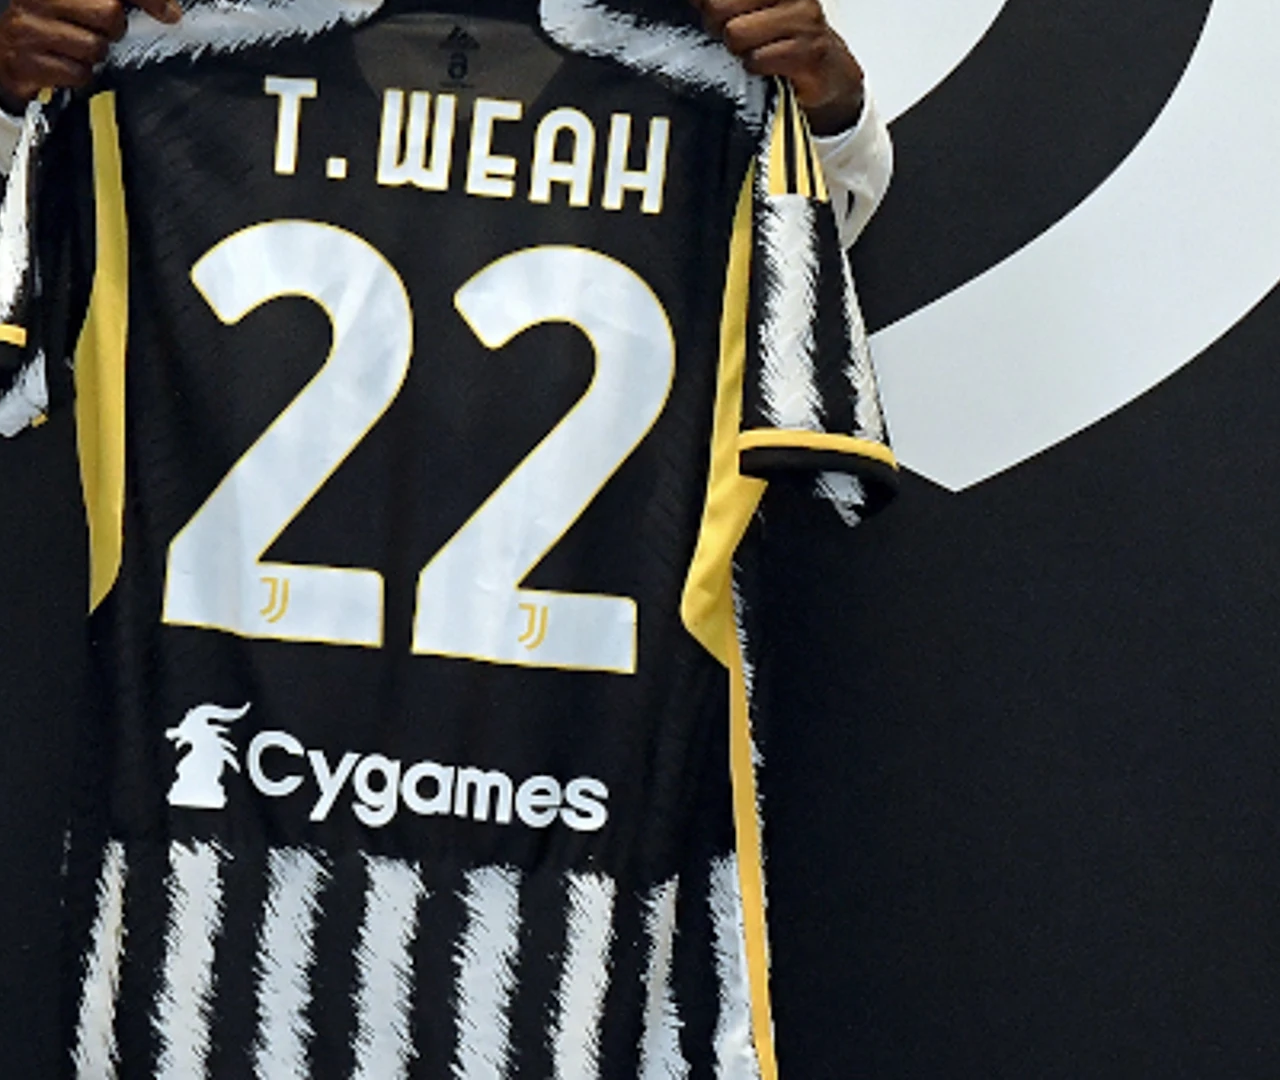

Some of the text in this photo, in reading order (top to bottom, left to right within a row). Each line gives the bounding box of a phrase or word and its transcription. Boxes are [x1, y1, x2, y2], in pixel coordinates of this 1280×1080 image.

[263, 75, 671, 215] T. WEAH
[161, 219, 676, 675] 22
[246, 730, 610, 831] Cygames
